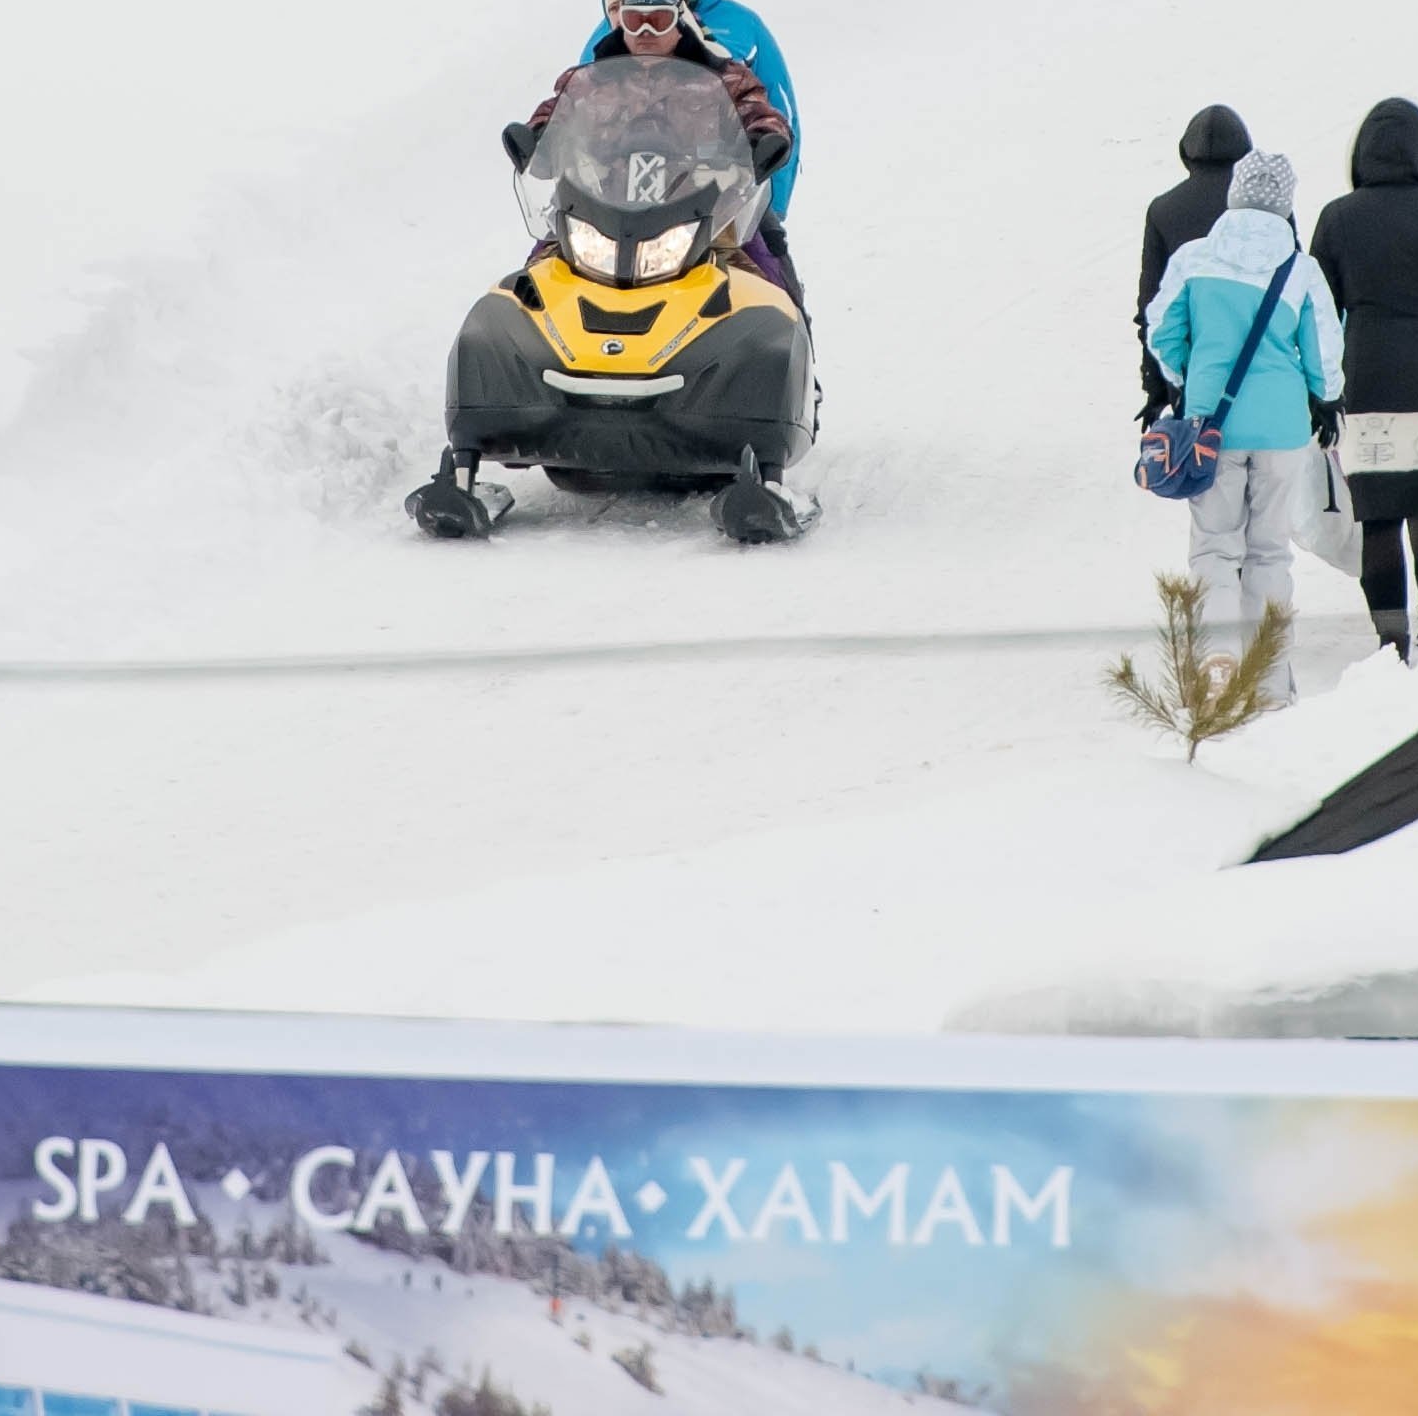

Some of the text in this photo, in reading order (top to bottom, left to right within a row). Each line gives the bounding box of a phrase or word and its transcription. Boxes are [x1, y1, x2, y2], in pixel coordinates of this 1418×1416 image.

[33, 1136, 1075, 1248] SPA САУНА ХАМАМ
